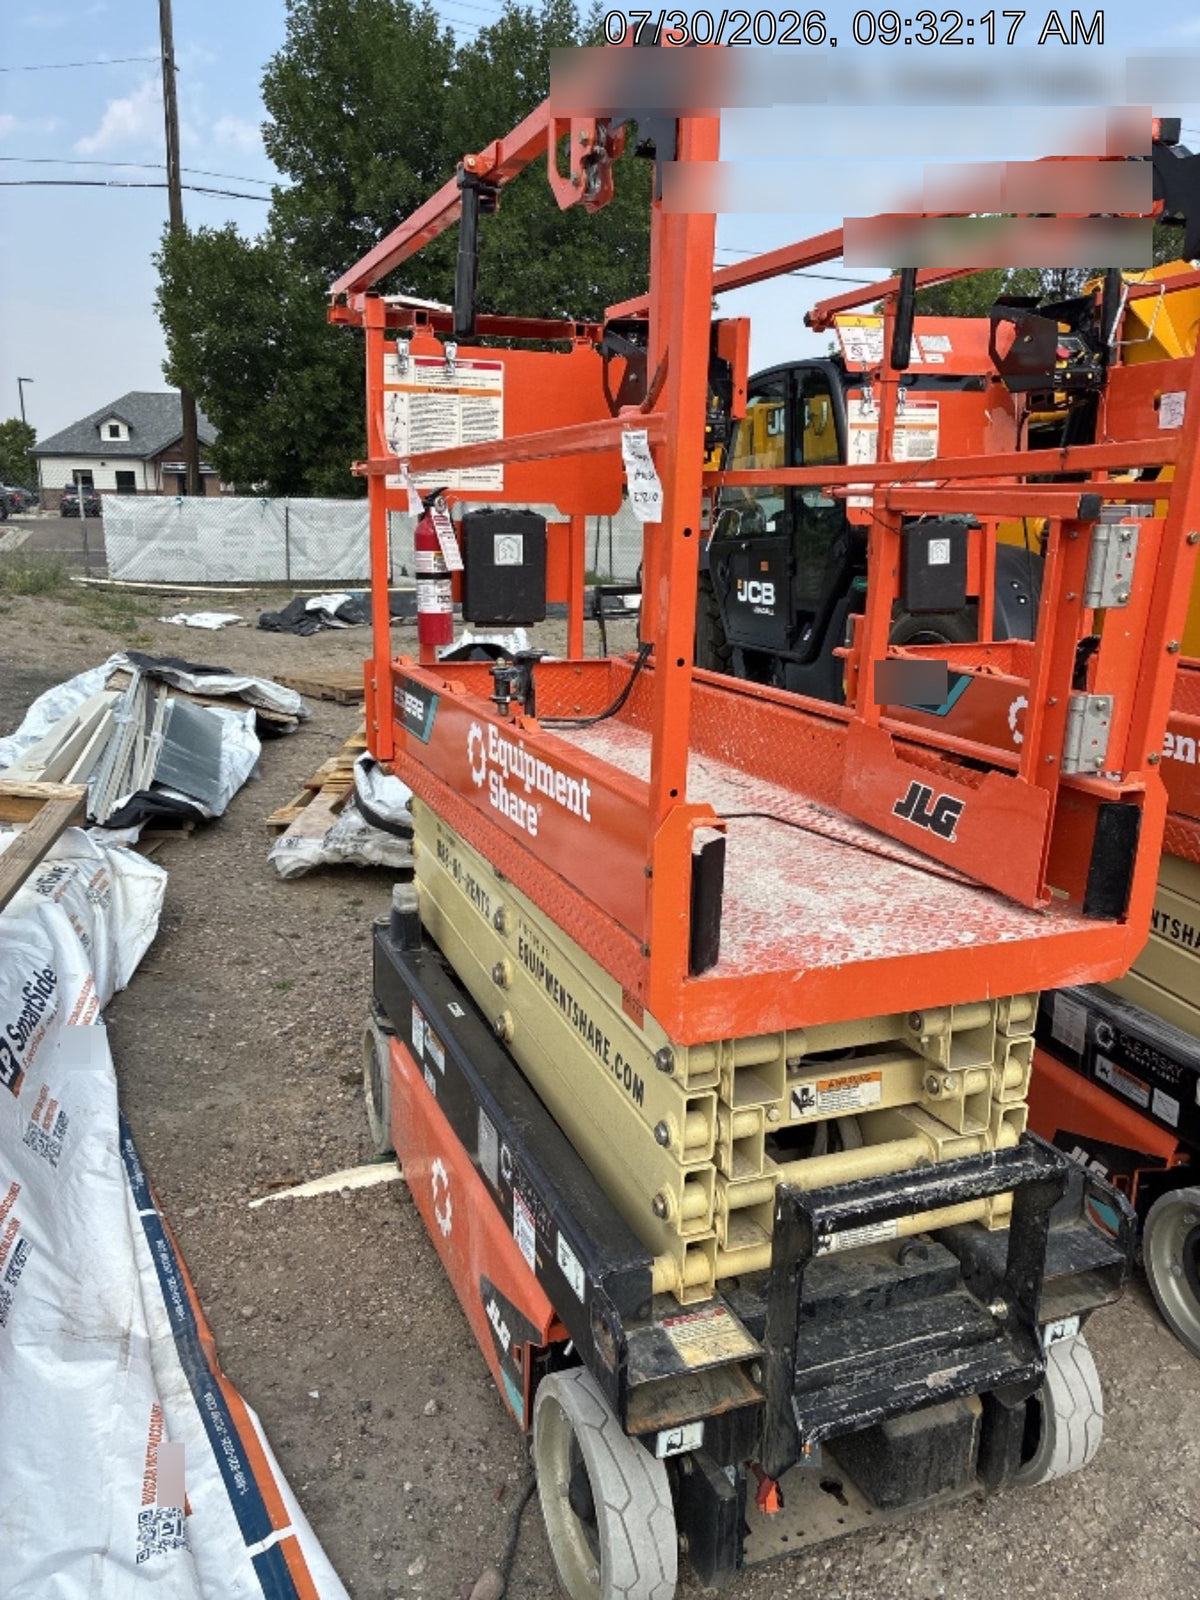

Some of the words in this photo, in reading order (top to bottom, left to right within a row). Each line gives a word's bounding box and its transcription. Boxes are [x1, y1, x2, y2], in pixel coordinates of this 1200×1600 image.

[736, 579, 776, 606] JCB
[487, 722, 592, 823] Equipment
[891, 780, 967, 841] JLG
[7, 967, 59, 1052] SmartSide
[518, 937, 645, 1108] EQUIPMENTSHARE.COM
[1119, 1034, 1184, 1078] CLEARSKY
